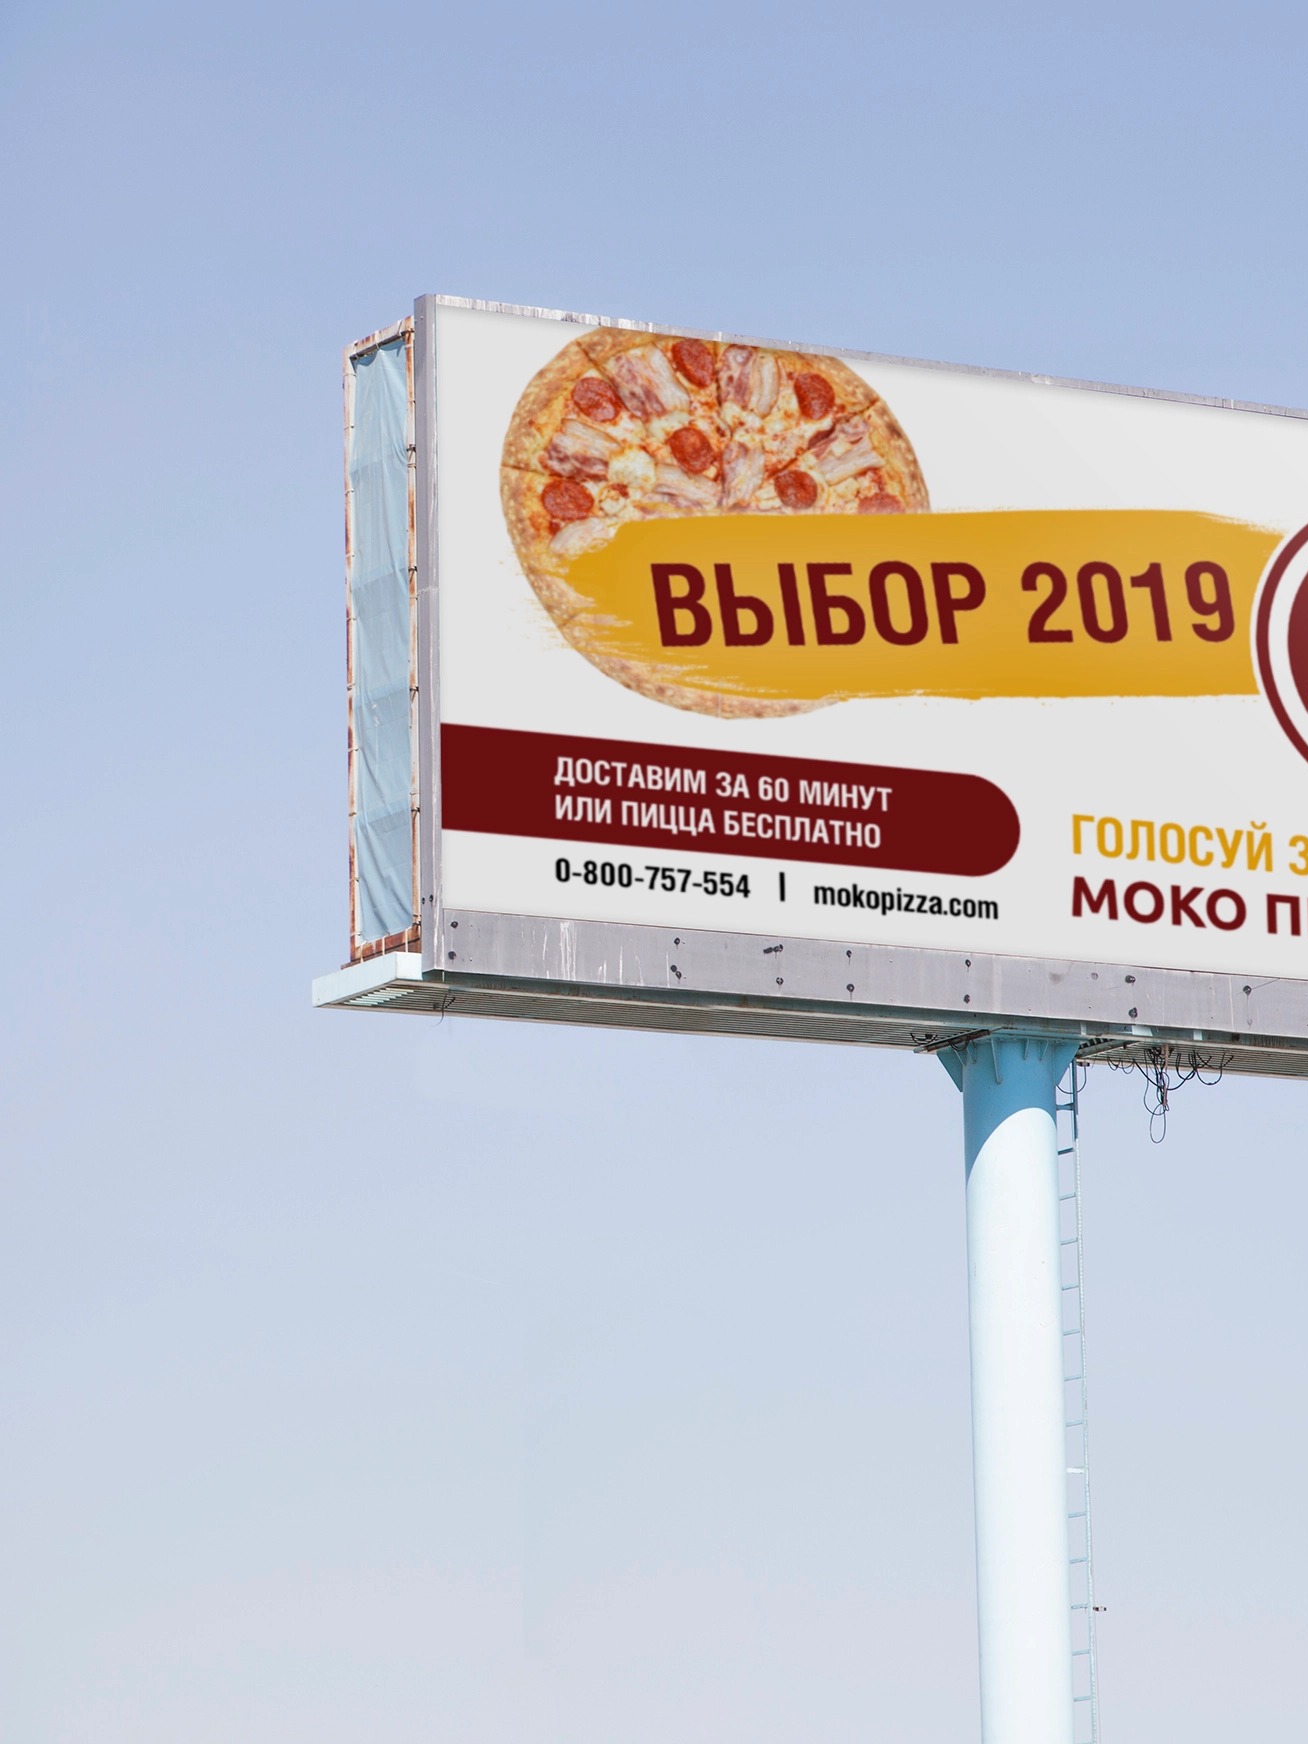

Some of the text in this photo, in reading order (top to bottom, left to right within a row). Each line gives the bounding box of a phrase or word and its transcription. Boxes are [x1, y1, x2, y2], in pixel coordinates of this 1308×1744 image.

[650, 560, 1235, 648] ВЫБОР 2019
[554, 756, 892, 812] ДОСТАВИМ ЗА 60 МИНУТ
[554, 795, 881, 849] ИЛИ ПИЦЦА БЕСПЛАТНО
[1072, 813, 1274, 872] ГОЛОСУЙ
[555, 858, 751, 899] 0-800-757-554
[814, 882, 999, 920] mokopizza.com
[1071, 876, 1247, 931] МОКО
